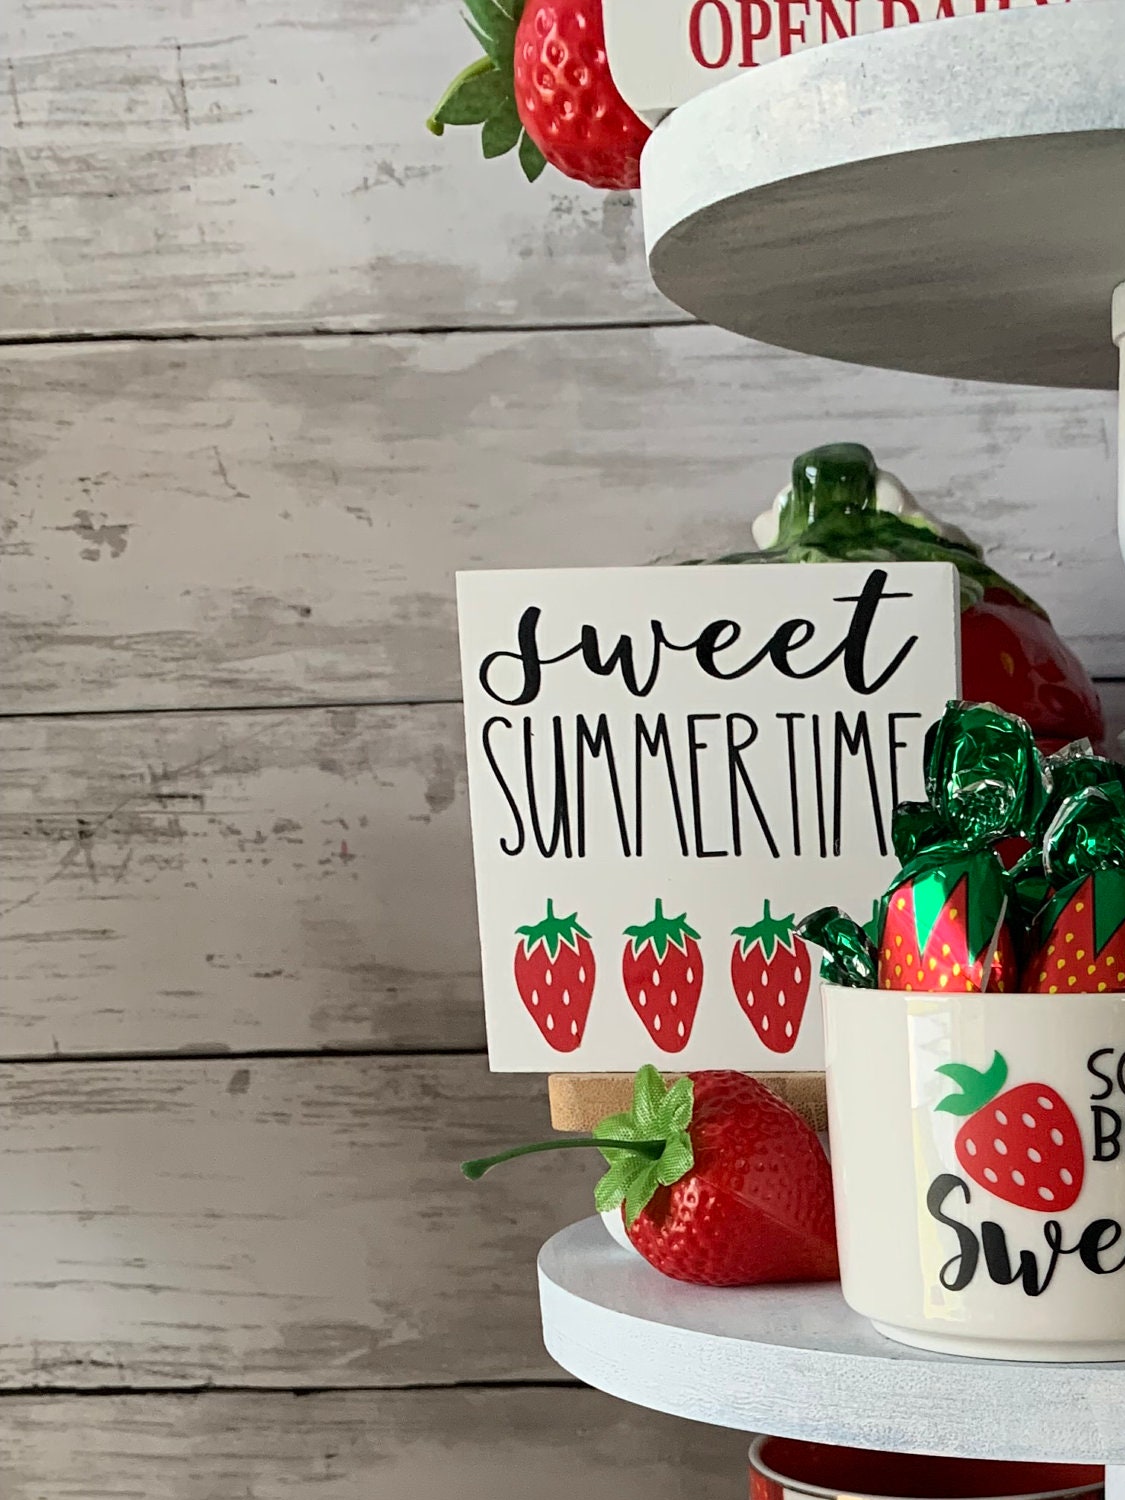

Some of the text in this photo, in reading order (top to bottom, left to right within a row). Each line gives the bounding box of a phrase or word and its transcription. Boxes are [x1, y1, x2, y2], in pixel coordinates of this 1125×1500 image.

[689, 0, 857, 69] OPEN
[479, 569, 919, 706] sweet
[482, 711, 922, 858] SUMMERTIME
